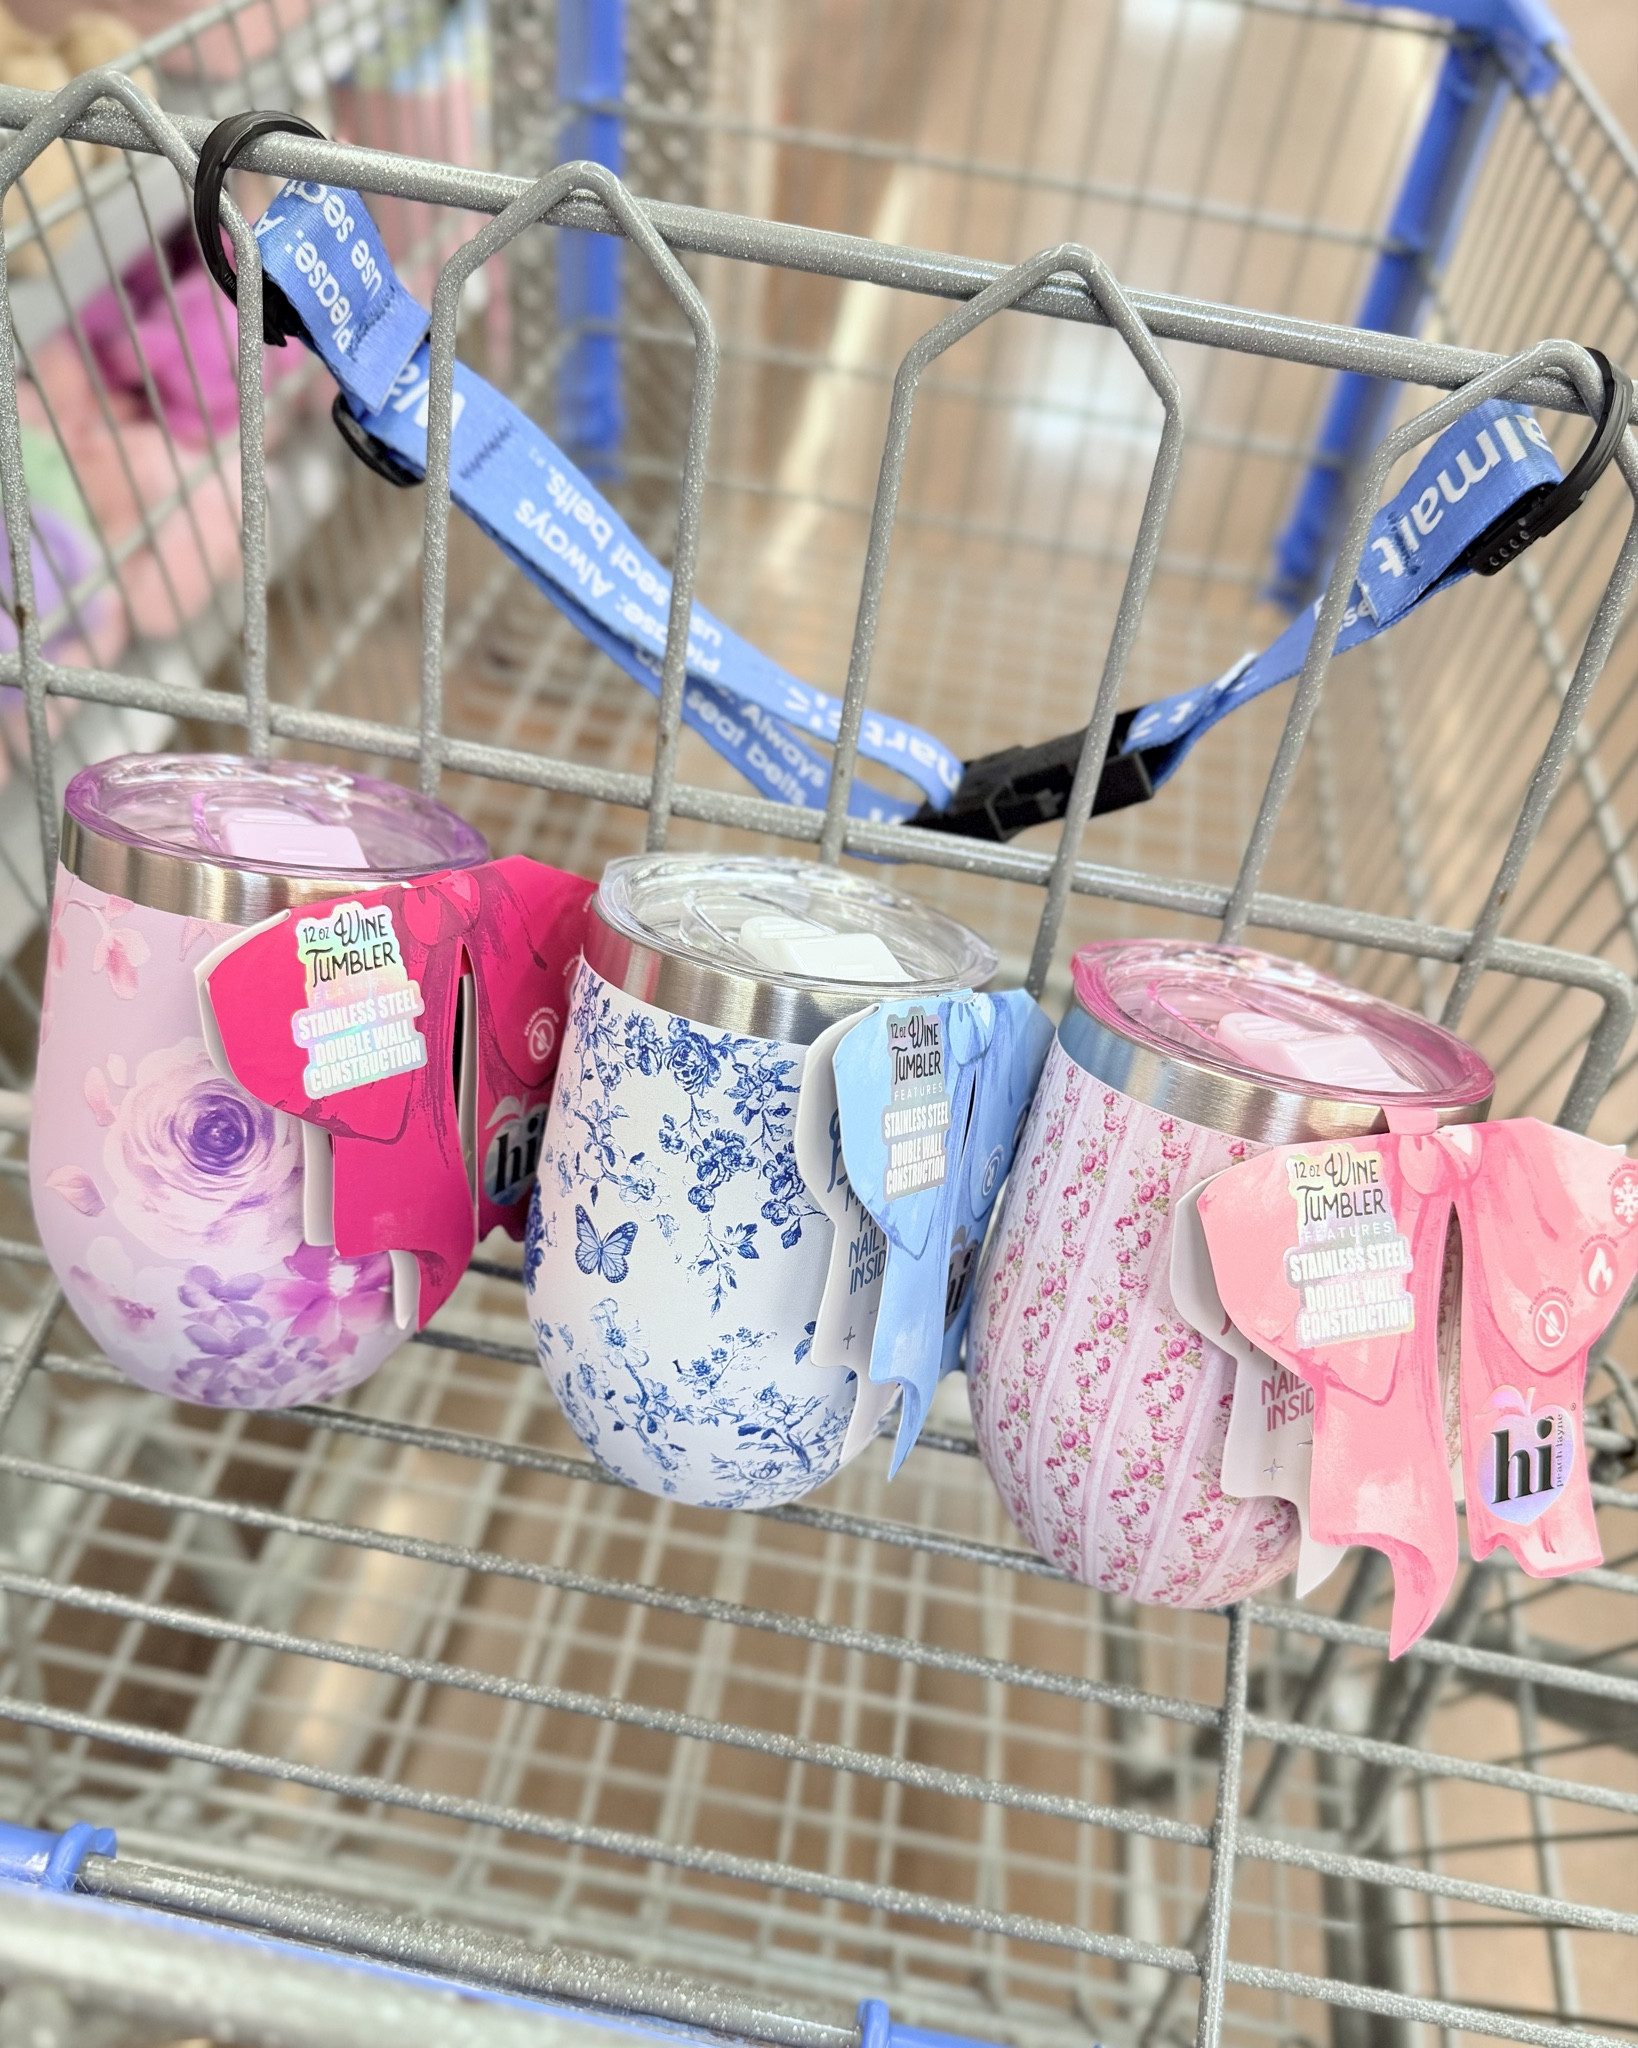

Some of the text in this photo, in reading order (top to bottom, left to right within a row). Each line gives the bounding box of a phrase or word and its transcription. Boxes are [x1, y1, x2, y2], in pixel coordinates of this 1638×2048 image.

[350, 239, 384, 297] use
[514, 497, 616, 599] Always
[610, 532, 671, 607] seat
[685, 689, 747, 749] seat
[739, 702, 829, 789] Always
[303, 925, 317, 944] 12
[305, 941, 397, 988] TUMBLER
[298, 987, 419, 1042] STAINLESS STEEL
[890, 1023, 899, 1039] 12
[314, 1018, 413, 1067] DOUBLE WALL
[308, 1039, 422, 1094] CONSTRUCTION
[891, 1045, 942, 1086] TUMBLER
[894, 1082, 944, 1102] FEATURES
[884, 1100, 949, 1140] STAINLESS STEEL
[495, 1115, 540, 1195] hi
[891, 1132, 943, 1169] DOUBLE WALL
[1294, 1161, 1307, 1179] 12
[886, 1154, 947, 1196] CONSTRUCTION
[1296, 1185, 1387, 1227] TUMBLER
[1304, 1220, 1393, 1243] FEATURES
[849, 1249, 887, 1296] INSID
[1288, 1240, 1408, 1283] STAINLESS STEEL
[1304, 1276, 1400, 1312] DOUBLE WALL
[1301, 1300, 1410, 1342] CONSTRUCTION
[1266, 1387, 1315, 1432] INSID
[1490, 1415, 1555, 1505] hi
